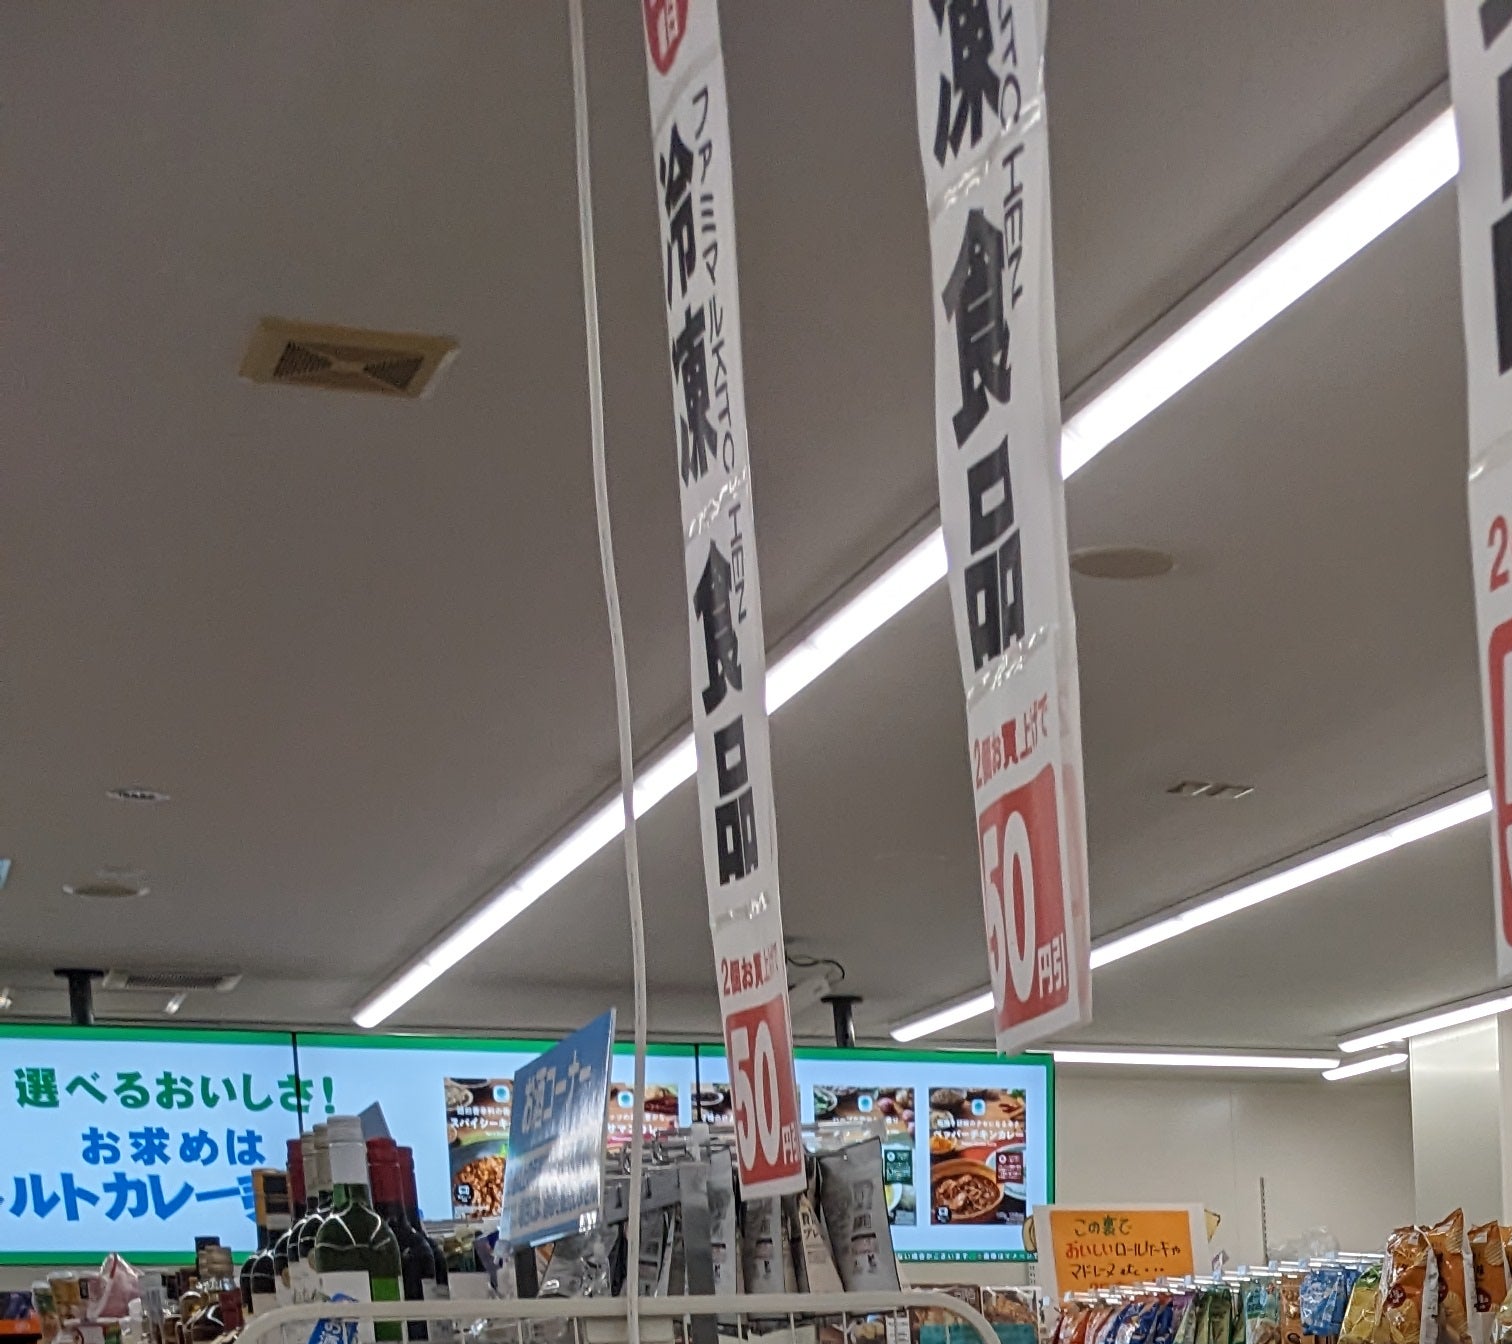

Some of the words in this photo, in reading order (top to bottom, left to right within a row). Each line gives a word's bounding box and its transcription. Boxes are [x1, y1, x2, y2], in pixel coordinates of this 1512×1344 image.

[658, 124, 760, 886] 冷凍食品
[973, 693, 1050, 789] 2個お買上げで
[720, 942, 781, 997] 2個お買上げで
[81, 1126, 266, 1168] お求めは
